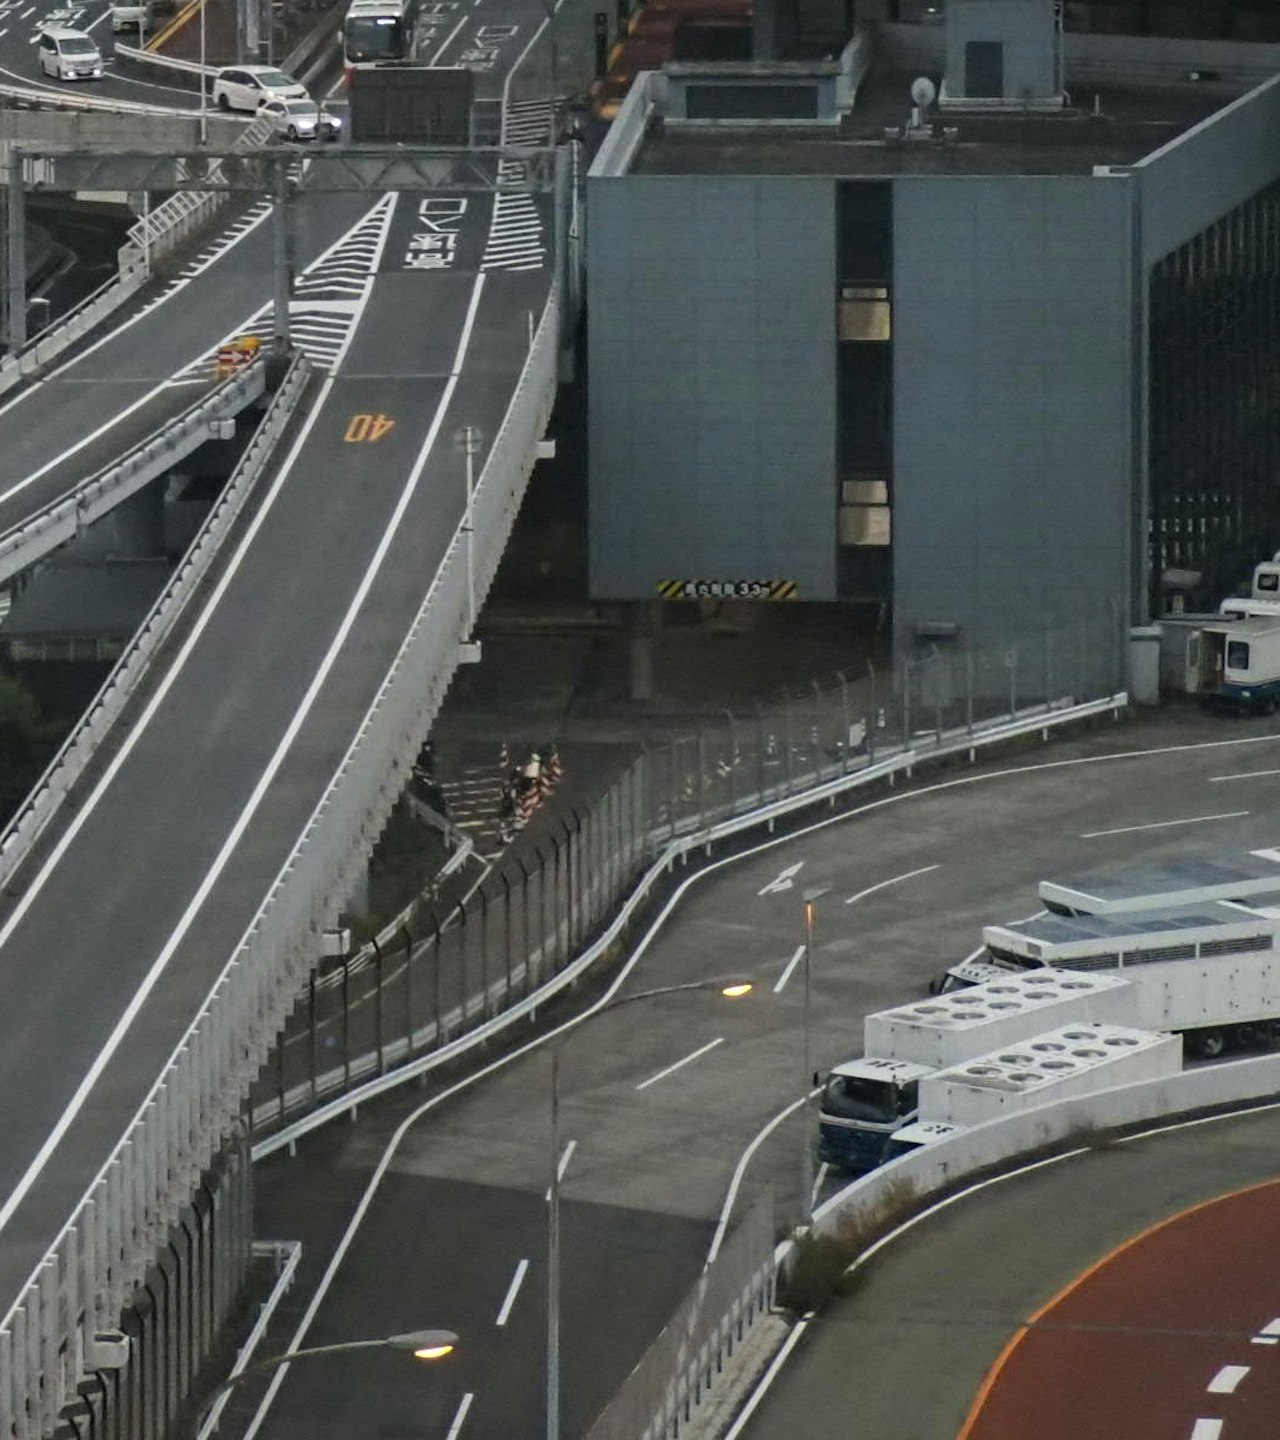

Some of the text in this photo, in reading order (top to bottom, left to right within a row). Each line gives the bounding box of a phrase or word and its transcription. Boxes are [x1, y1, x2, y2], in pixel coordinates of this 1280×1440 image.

[402, 197, 469, 269] 高速入口
[343, 414, 397, 443] 40
